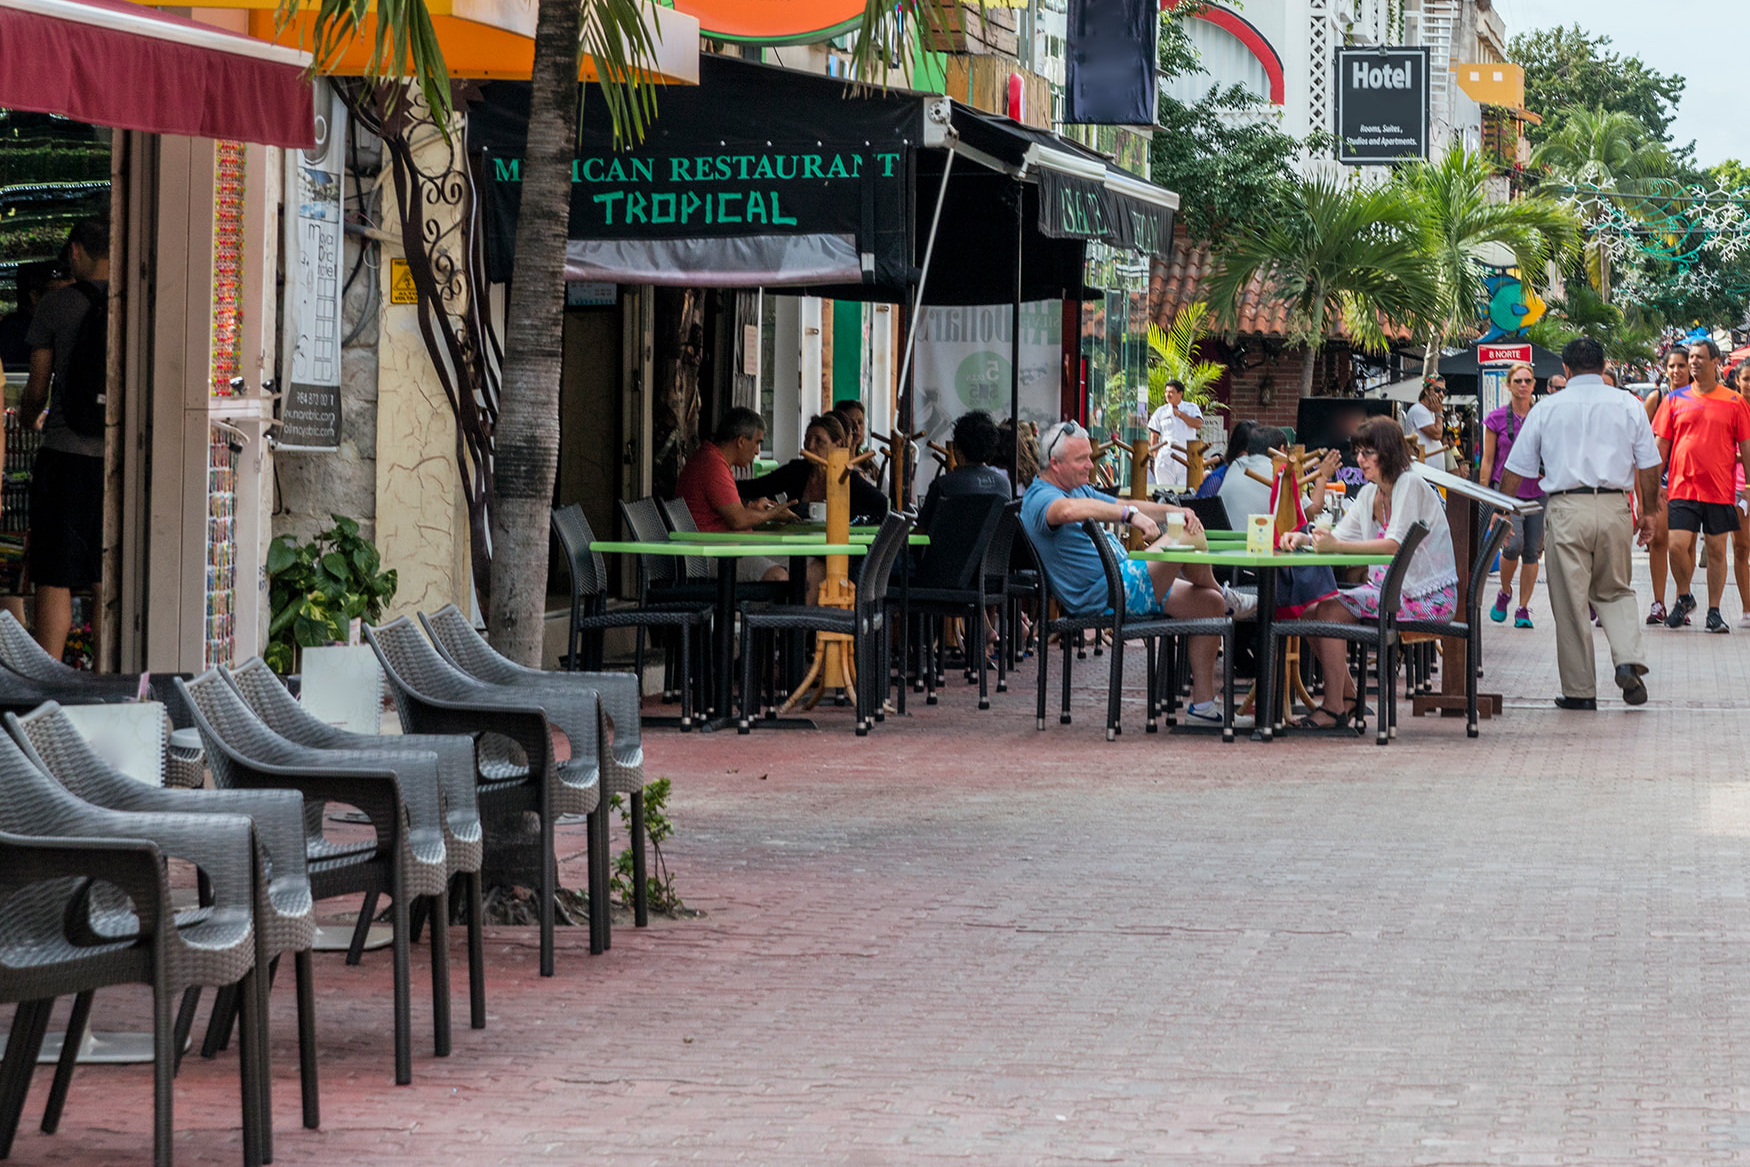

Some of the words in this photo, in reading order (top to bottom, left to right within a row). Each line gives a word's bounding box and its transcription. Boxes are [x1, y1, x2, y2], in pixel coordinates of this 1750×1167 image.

[1353, 60, 1412, 89] Hotel
[1369, 137, 1380, 145] and
[493, 157, 655, 183] MICAN
[593, 190, 798, 226] TROPICAL
[1489, 350, 1494, 359] 8
[1495, 350, 1521, 359] NORTE
